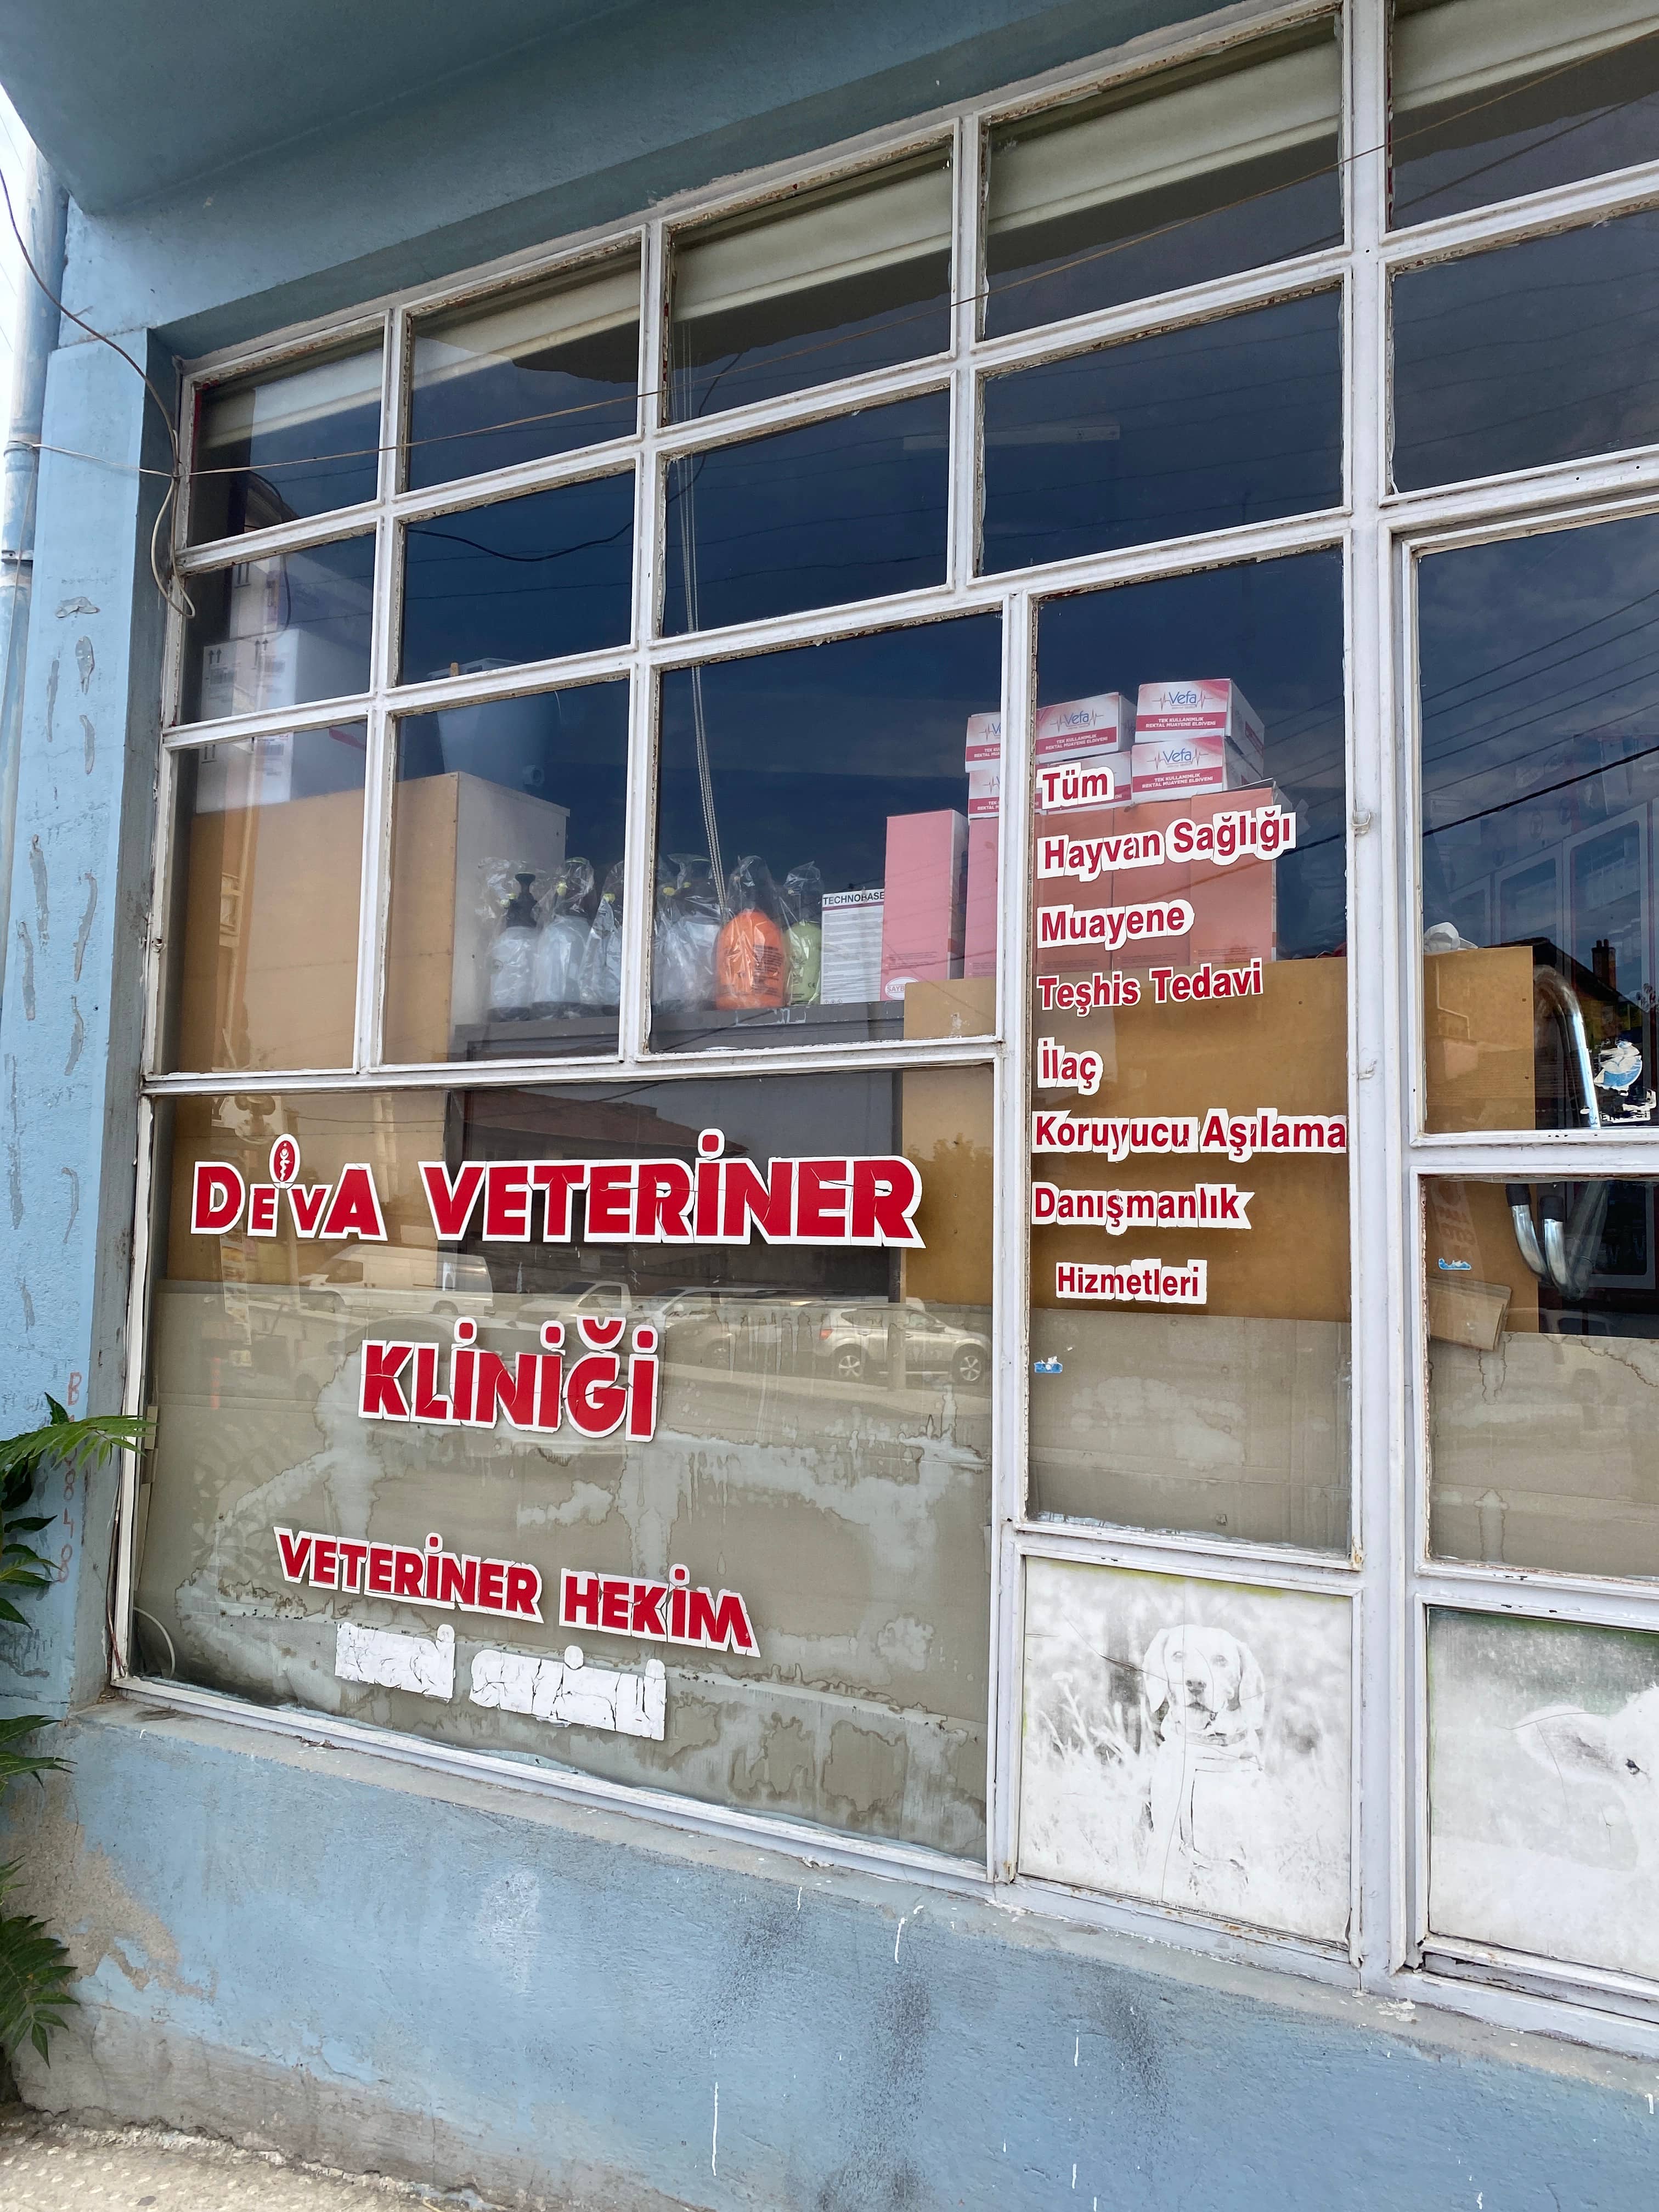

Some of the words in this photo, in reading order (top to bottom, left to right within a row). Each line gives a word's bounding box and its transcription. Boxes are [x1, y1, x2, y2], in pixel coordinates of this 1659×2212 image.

[1169, 690, 1197, 704] Vefa
[1064, 710, 1089, 725] Vefa
[1066, 734, 1097, 743] KULLANIMLIK
[1163, 748, 1192, 763] Vefa
[1042, 769, 1108, 803] Tüm
[1165, 773, 1201, 781] KULLANIMLIK
[1044, 833, 1161, 874] Hayvan
[1173, 812, 1291, 857] Sağlığı
[1041, 906, 1186, 946] Muayene
[1037, 973, 1140, 1015] Teşhis
[1150, 960, 1261, 1002] Tedavi
[1041, 1039, 1098, 1090] İlaç
[1035, 1115, 1190, 1155] Koruyucu
[1202, 1115, 1346, 1156] Aşılama
[421, 1132, 919, 1242] VETERİNER
[1034, 1187, 1240, 1228] Danışmanlık
[1057, 1265, 1199, 1298] Hizmetleri
[361, 1318, 656, 1438] KLİNİĞİ
[277, 1534, 540, 1617] VETERİNER
[563, 1567, 754, 1649] HEKİM
